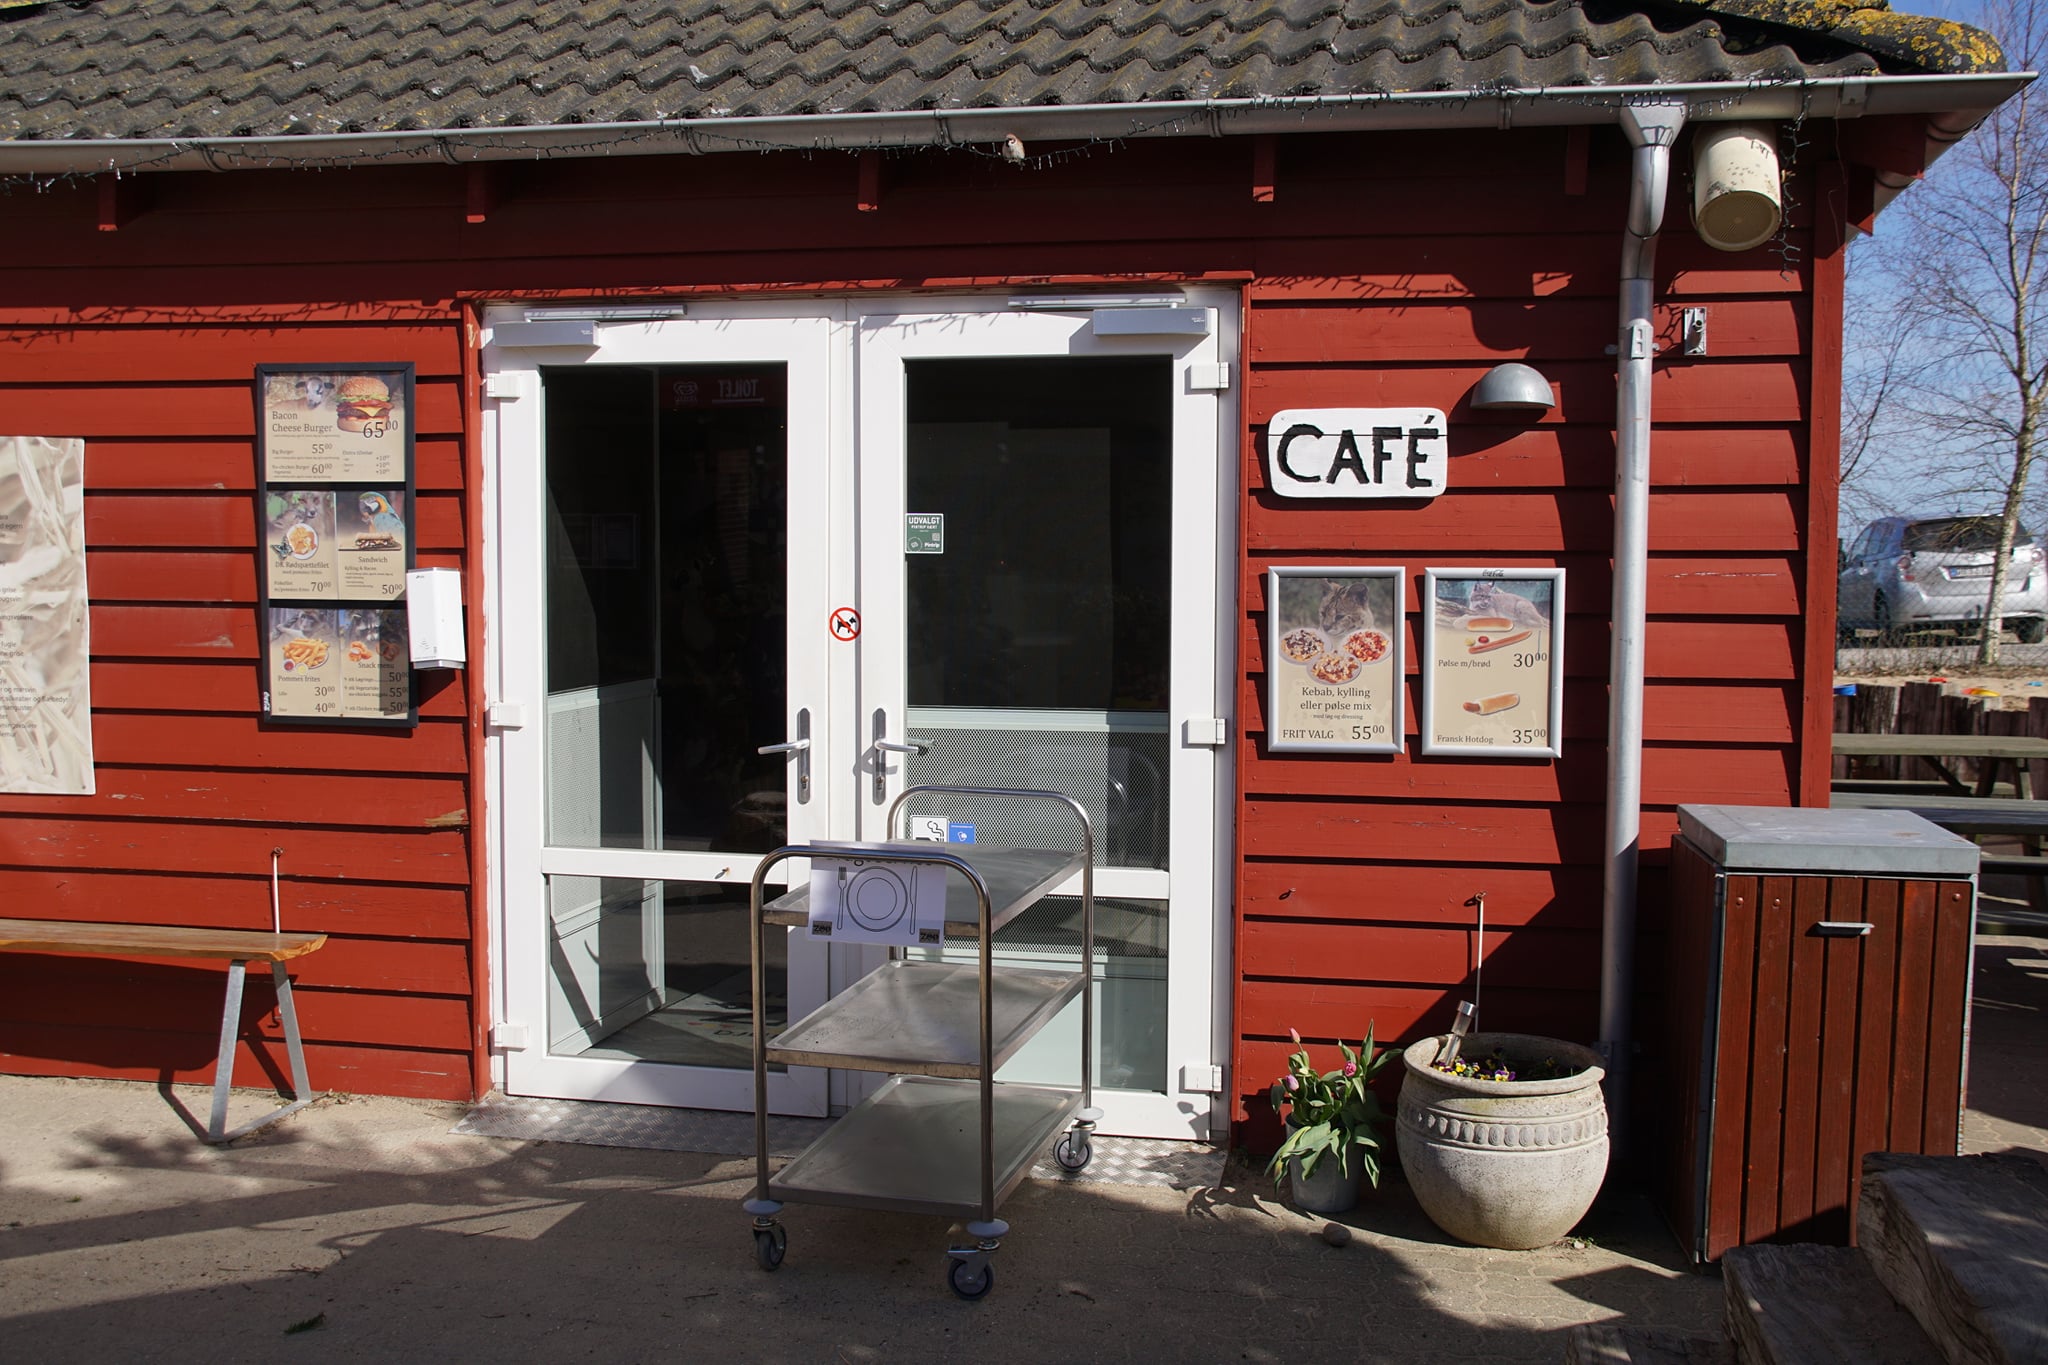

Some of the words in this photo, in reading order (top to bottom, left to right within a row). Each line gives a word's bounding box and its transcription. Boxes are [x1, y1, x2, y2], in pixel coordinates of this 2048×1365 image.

[272, 411, 298, 420] Bacon
[272, 423, 303, 432] Cheese
[304, 424, 333, 434] Burger
[1277, 415, 1439, 489] CAFÉ
[908, 516, 940, 525] UDVALGT
[1460, 660, 1491, 669] m/brød
[1302, 687, 1335, 697] Kebab,
[1337, 687, 1371, 699] kylling
[1300, 701, 1322, 710] eller
[1325, 701, 1351, 712] pølse
[1353, 702, 1372, 711] mix
[1282, 729, 1306, 739] FRIT
[1308, 730, 1334, 739] VALG
[1437, 734, 1464, 743] Fransk
[1465, 735, 1494, 745] Hotdog
